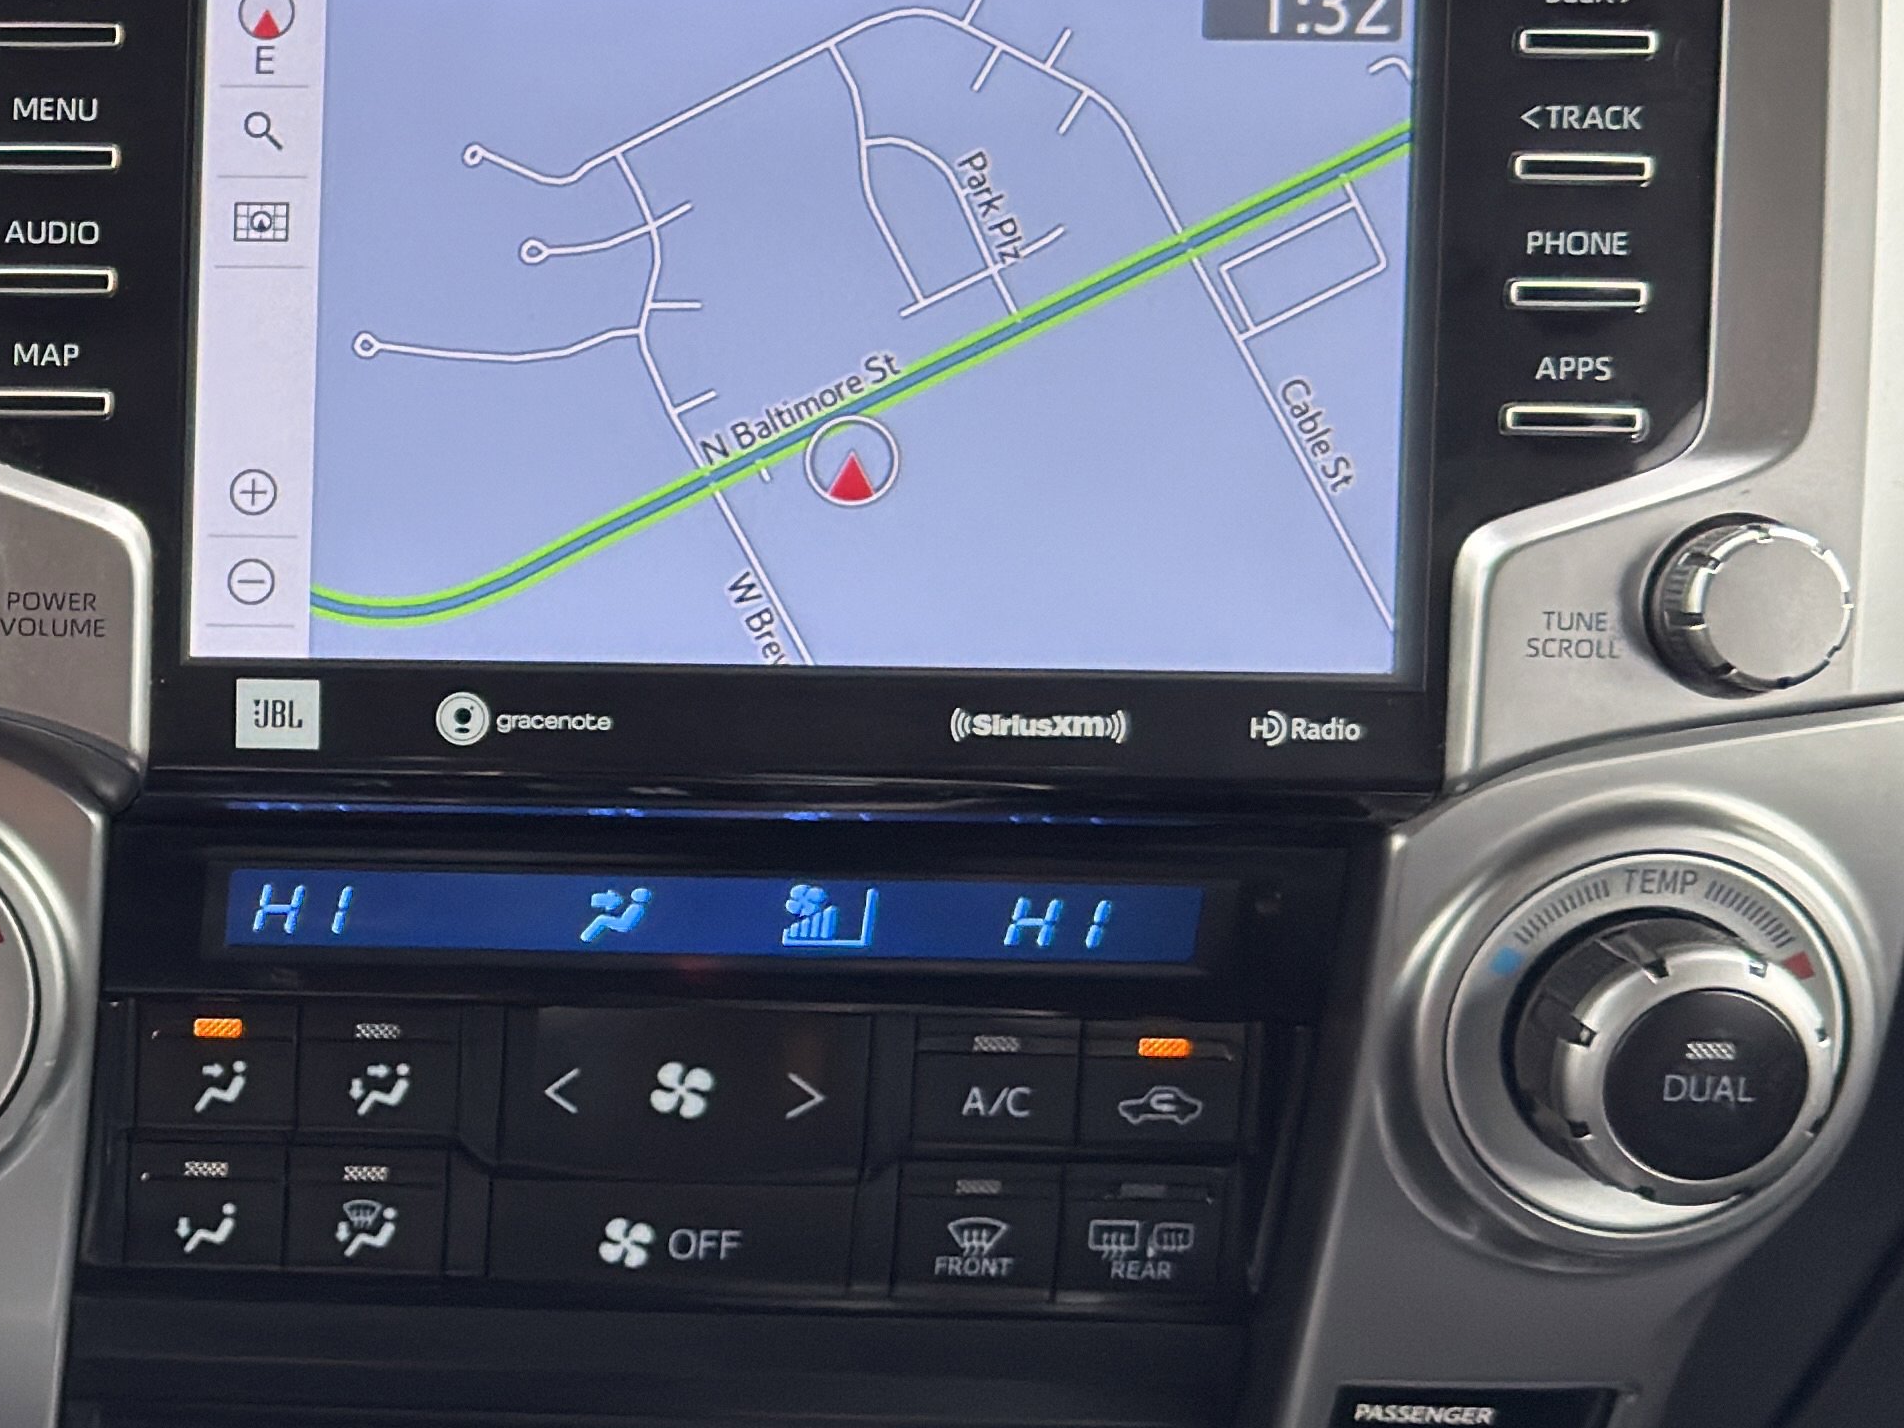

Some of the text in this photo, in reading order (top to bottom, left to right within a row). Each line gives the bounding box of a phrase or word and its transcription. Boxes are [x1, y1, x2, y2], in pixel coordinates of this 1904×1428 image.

[254, 45, 276, 75] E
[12, 97, 99, 122] MENU
[957, 150, 1023, 265] Park Plz
[4, 220, 101, 245] AUDIO
[1526, 230, 1629, 256] PHONE
[13, 343, 80, 368] MAP
[1534, 356, 1615, 382] APPS
[699, 352, 902, 466] N Baltimore St
[1281, 378, 1353, 493] Cable St
[727, 570, 763, 605] W
[6, 591, 98, 612] POWER
[0, 617, 108, 638] VOLUME
[1542, 611, 1608, 633] TUNE
[1524, 637, 1621, 660] SCROLL
[253, 698, 305, 730] JBL
[495, 712, 613, 735] gracenote
[1291, 717, 1362, 742] Radio
[1622, 868, 1699, 895] TEMP
[1662, 1074, 1757, 1105] DUAL
[961, 1086, 1033, 1119] A/C
[667, 1228, 744, 1262] OFF
[934, 1256, 1014, 1279] FRONT
[1109, 1258, 1173, 1282] REAR
[1353, 1402, 1497, 1426] PASSENGER
